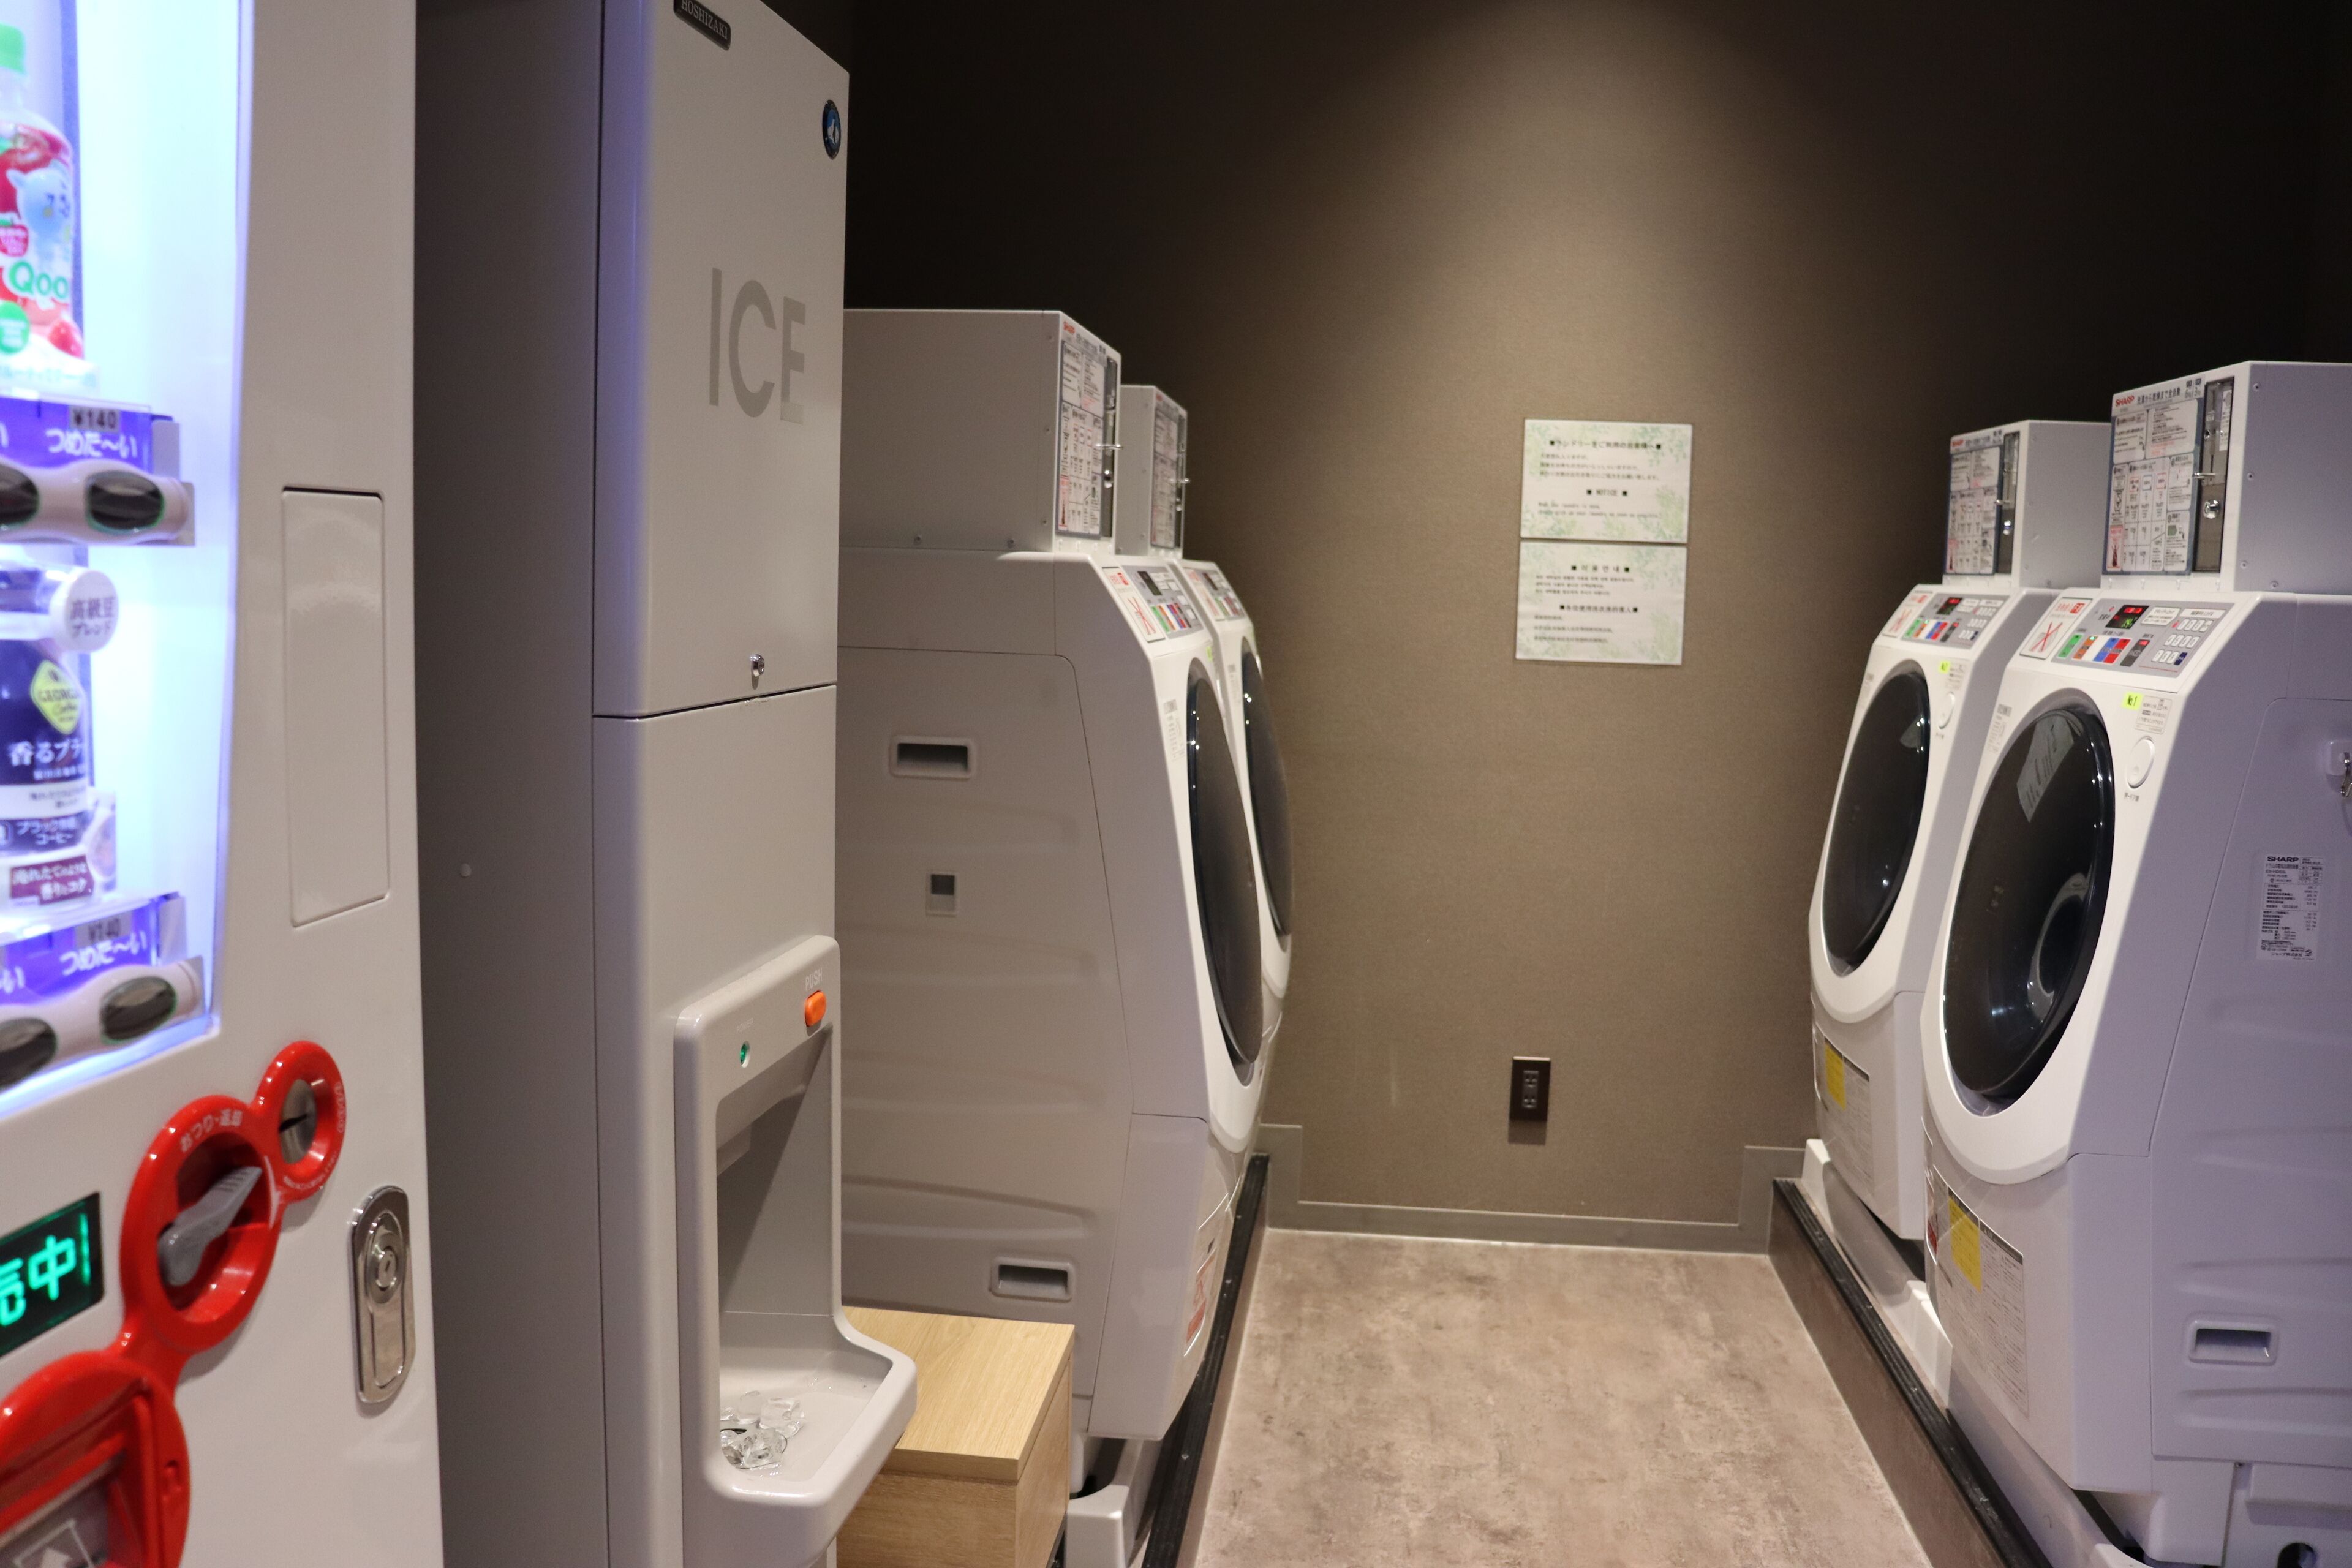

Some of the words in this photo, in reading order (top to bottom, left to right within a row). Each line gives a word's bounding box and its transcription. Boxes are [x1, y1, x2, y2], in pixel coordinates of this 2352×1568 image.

[681, 0, 728, 40] HOSHIZAKI
[9, 260, 69, 299] Qoo
[709, 267, 806, 425] ICE
[805, 967, 823, 990] PUSH
